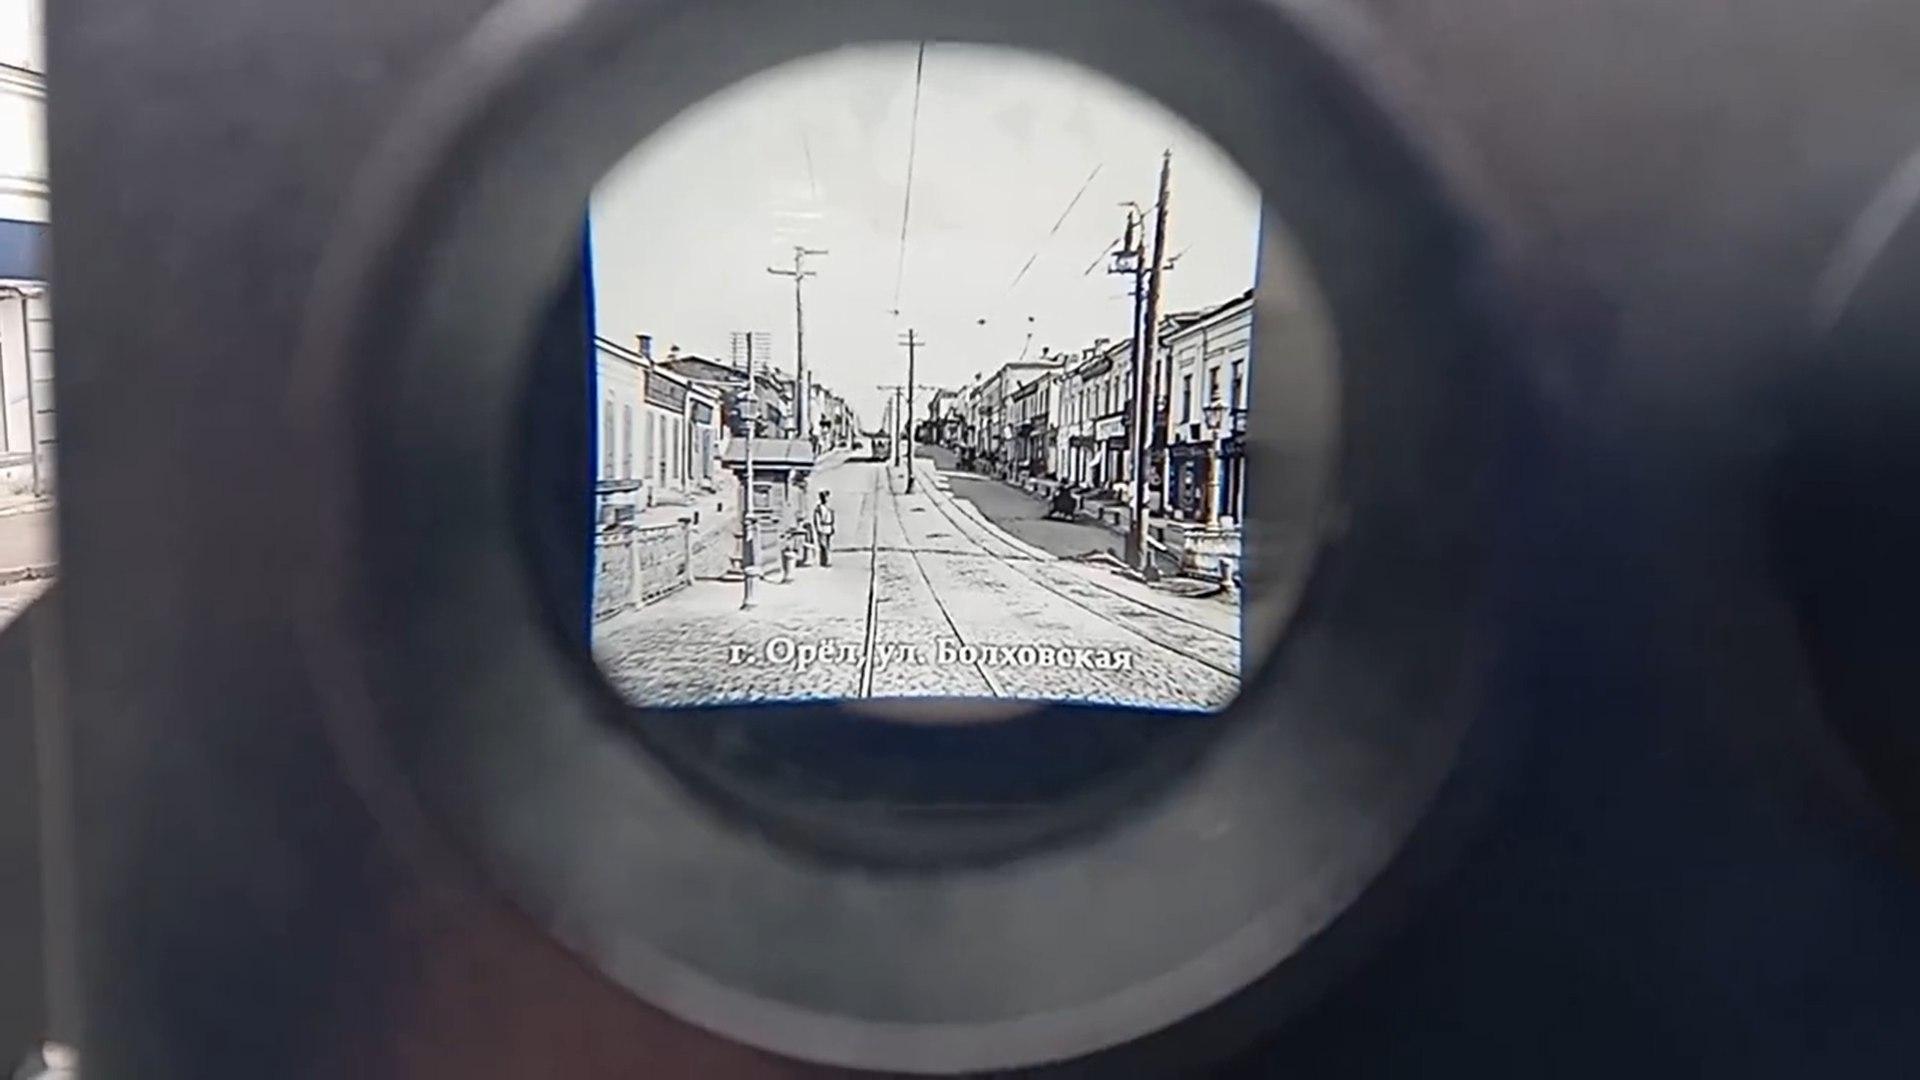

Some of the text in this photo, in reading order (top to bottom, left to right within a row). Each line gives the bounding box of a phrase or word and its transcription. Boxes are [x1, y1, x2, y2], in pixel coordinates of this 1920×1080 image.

[728, 645, 755, 665] г.
[876, 645, 926, 672] ул.
[936, 637, 1134, 671] Болховская
